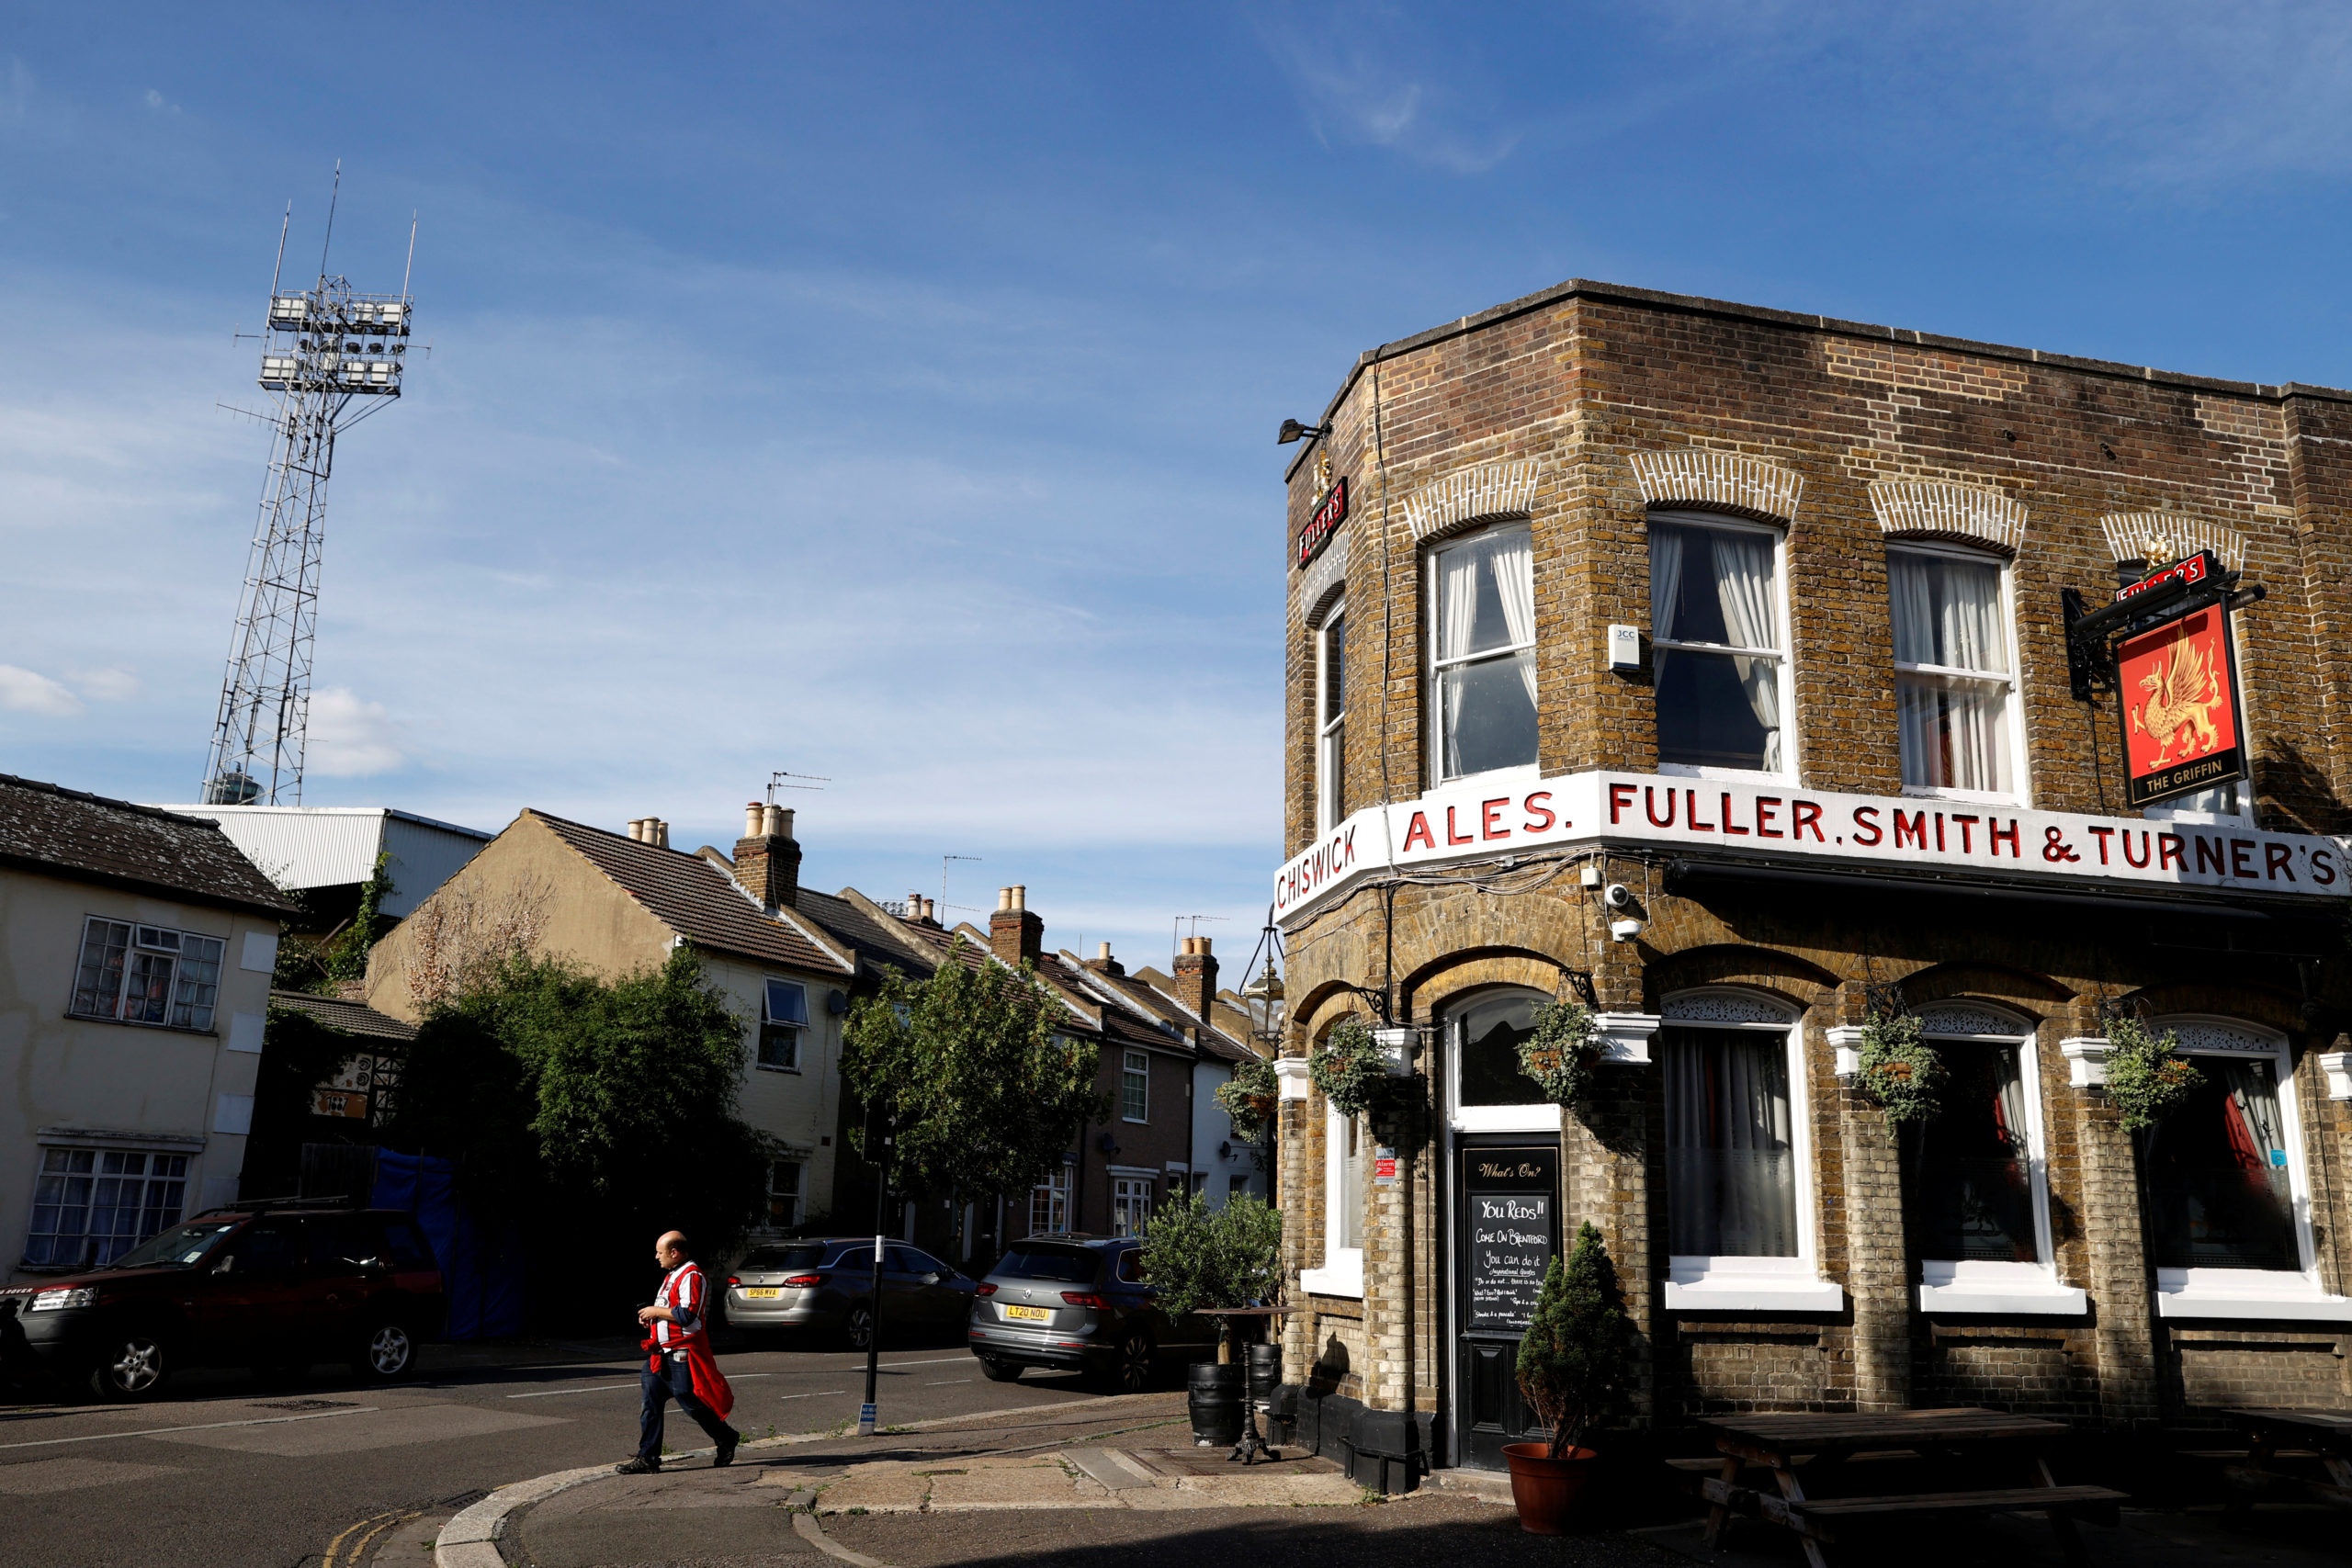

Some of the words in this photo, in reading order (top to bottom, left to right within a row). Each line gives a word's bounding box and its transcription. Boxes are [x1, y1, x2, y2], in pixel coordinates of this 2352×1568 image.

[1617, 630, 1634, 638] JCC
[2146, 772, 2169, 793] THE
[2173, 760, 2222, 784] GRIFFIN
[1276, 823, 1357, 909] CHISWICK
[1403, 791, 1574, 852] ALES.
[2041, 825, 2081, 863] &
[2087, 825, 2337, 885] TURNER'S
[1478, 1162, 1514, 1179] What's
[1518, 1162, 1542, 1178] On?
[1483, 1249, 1501, 1269] You
[1504, 1255, 1520, 1265] can
[1521, 1253, 1532, 1267] do
[1532, 1255, 1541, 1267] it
[1010, 1306, 1029, 1316] LT20
